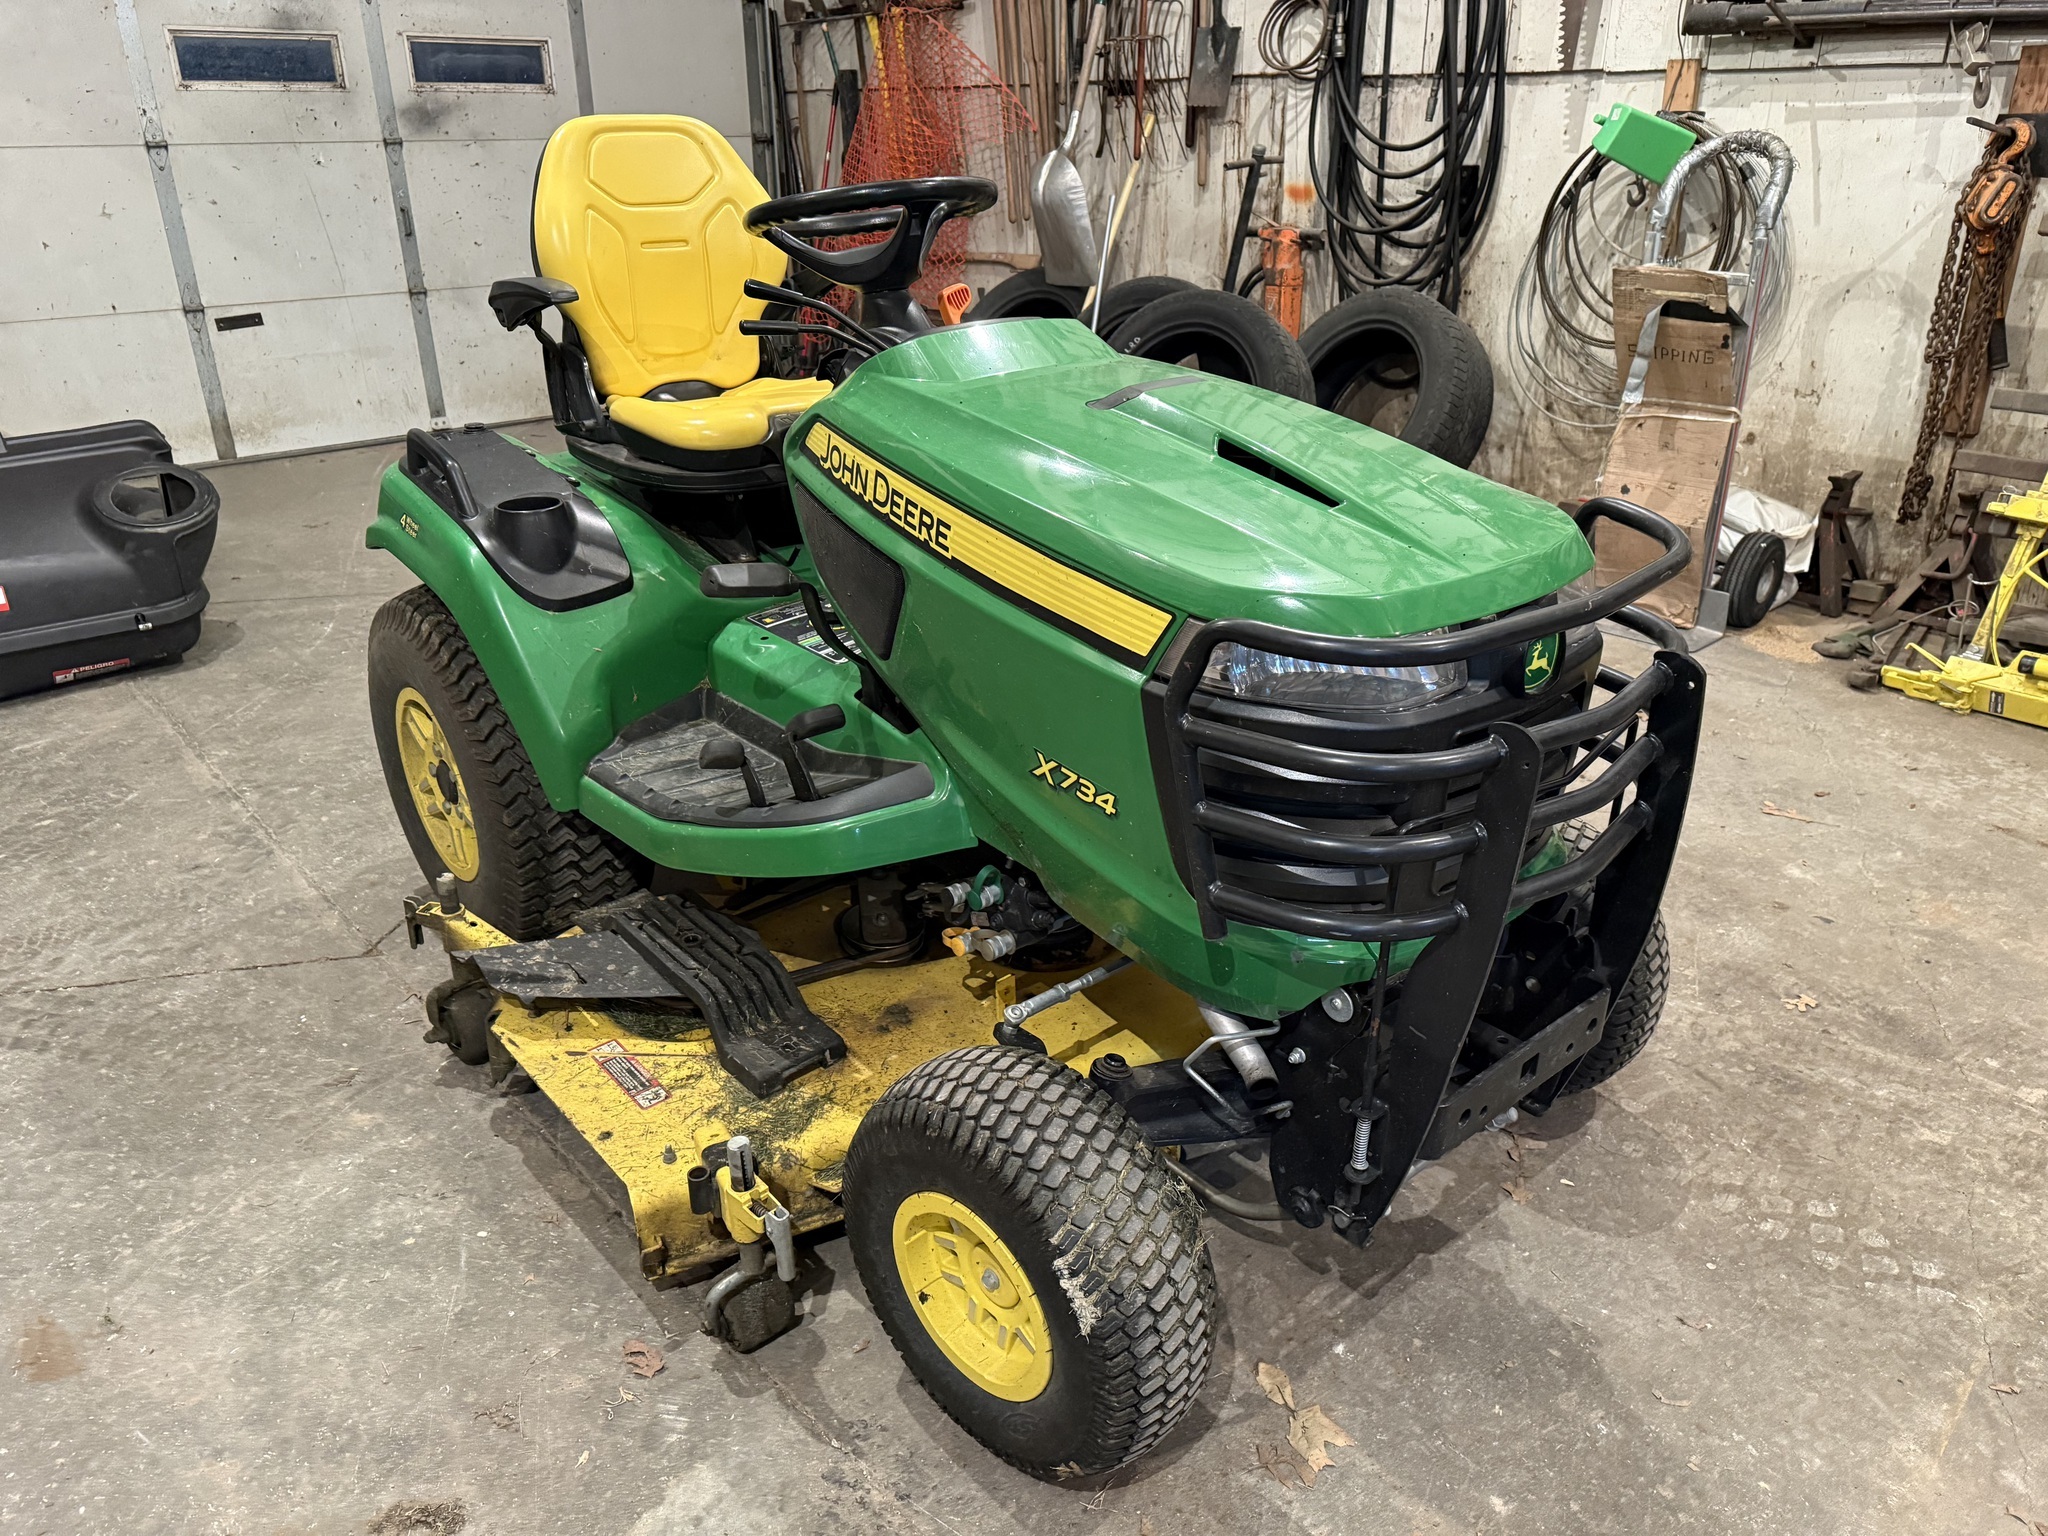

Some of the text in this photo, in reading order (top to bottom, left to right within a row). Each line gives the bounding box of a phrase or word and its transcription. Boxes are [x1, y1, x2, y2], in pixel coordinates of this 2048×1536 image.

[1627, 343, 1715, 365] SIPPING
[820, 433, 869, 496] JOHN
[400, 513, 406, 528] 4
[79, 661, 115, 672] PELIGRO
[1031, 750, 1117, 816] X734
